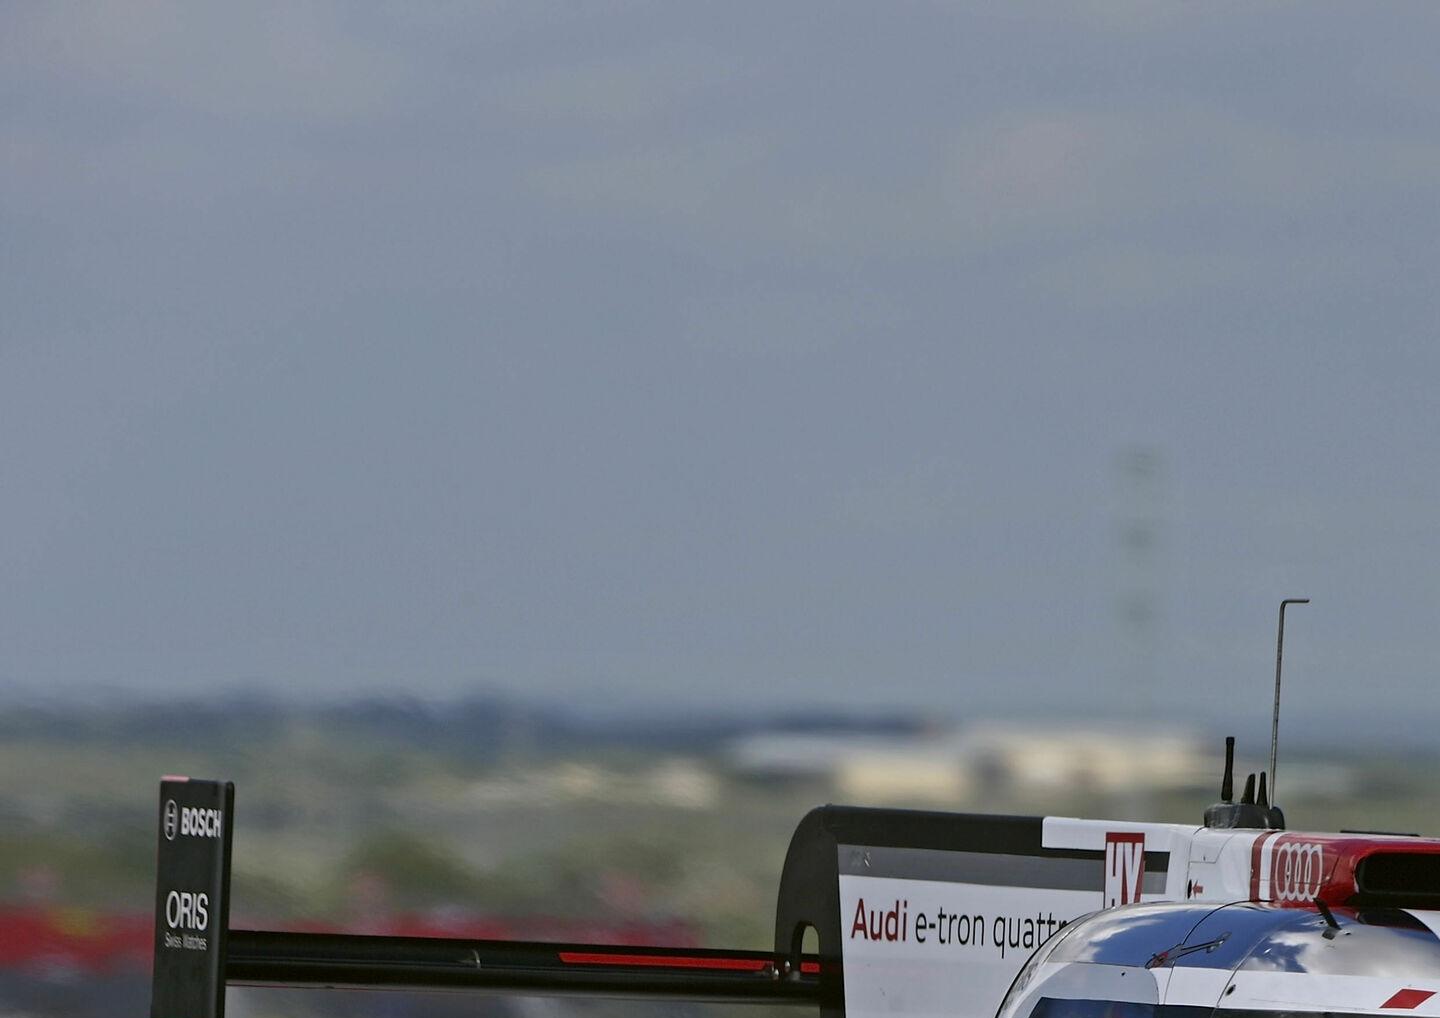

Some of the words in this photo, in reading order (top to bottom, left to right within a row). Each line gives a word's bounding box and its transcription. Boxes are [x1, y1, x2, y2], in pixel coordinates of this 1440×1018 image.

[181, 807, 222, 838] BOSCH
[1105, 842, 1144, 908] HY
[166, 890, 209, 931] ORIS
[851, 898, 908, 942] Audi
[915, 906, 985, 946] e-tron
[165, 931, 183, 948] Swiss
